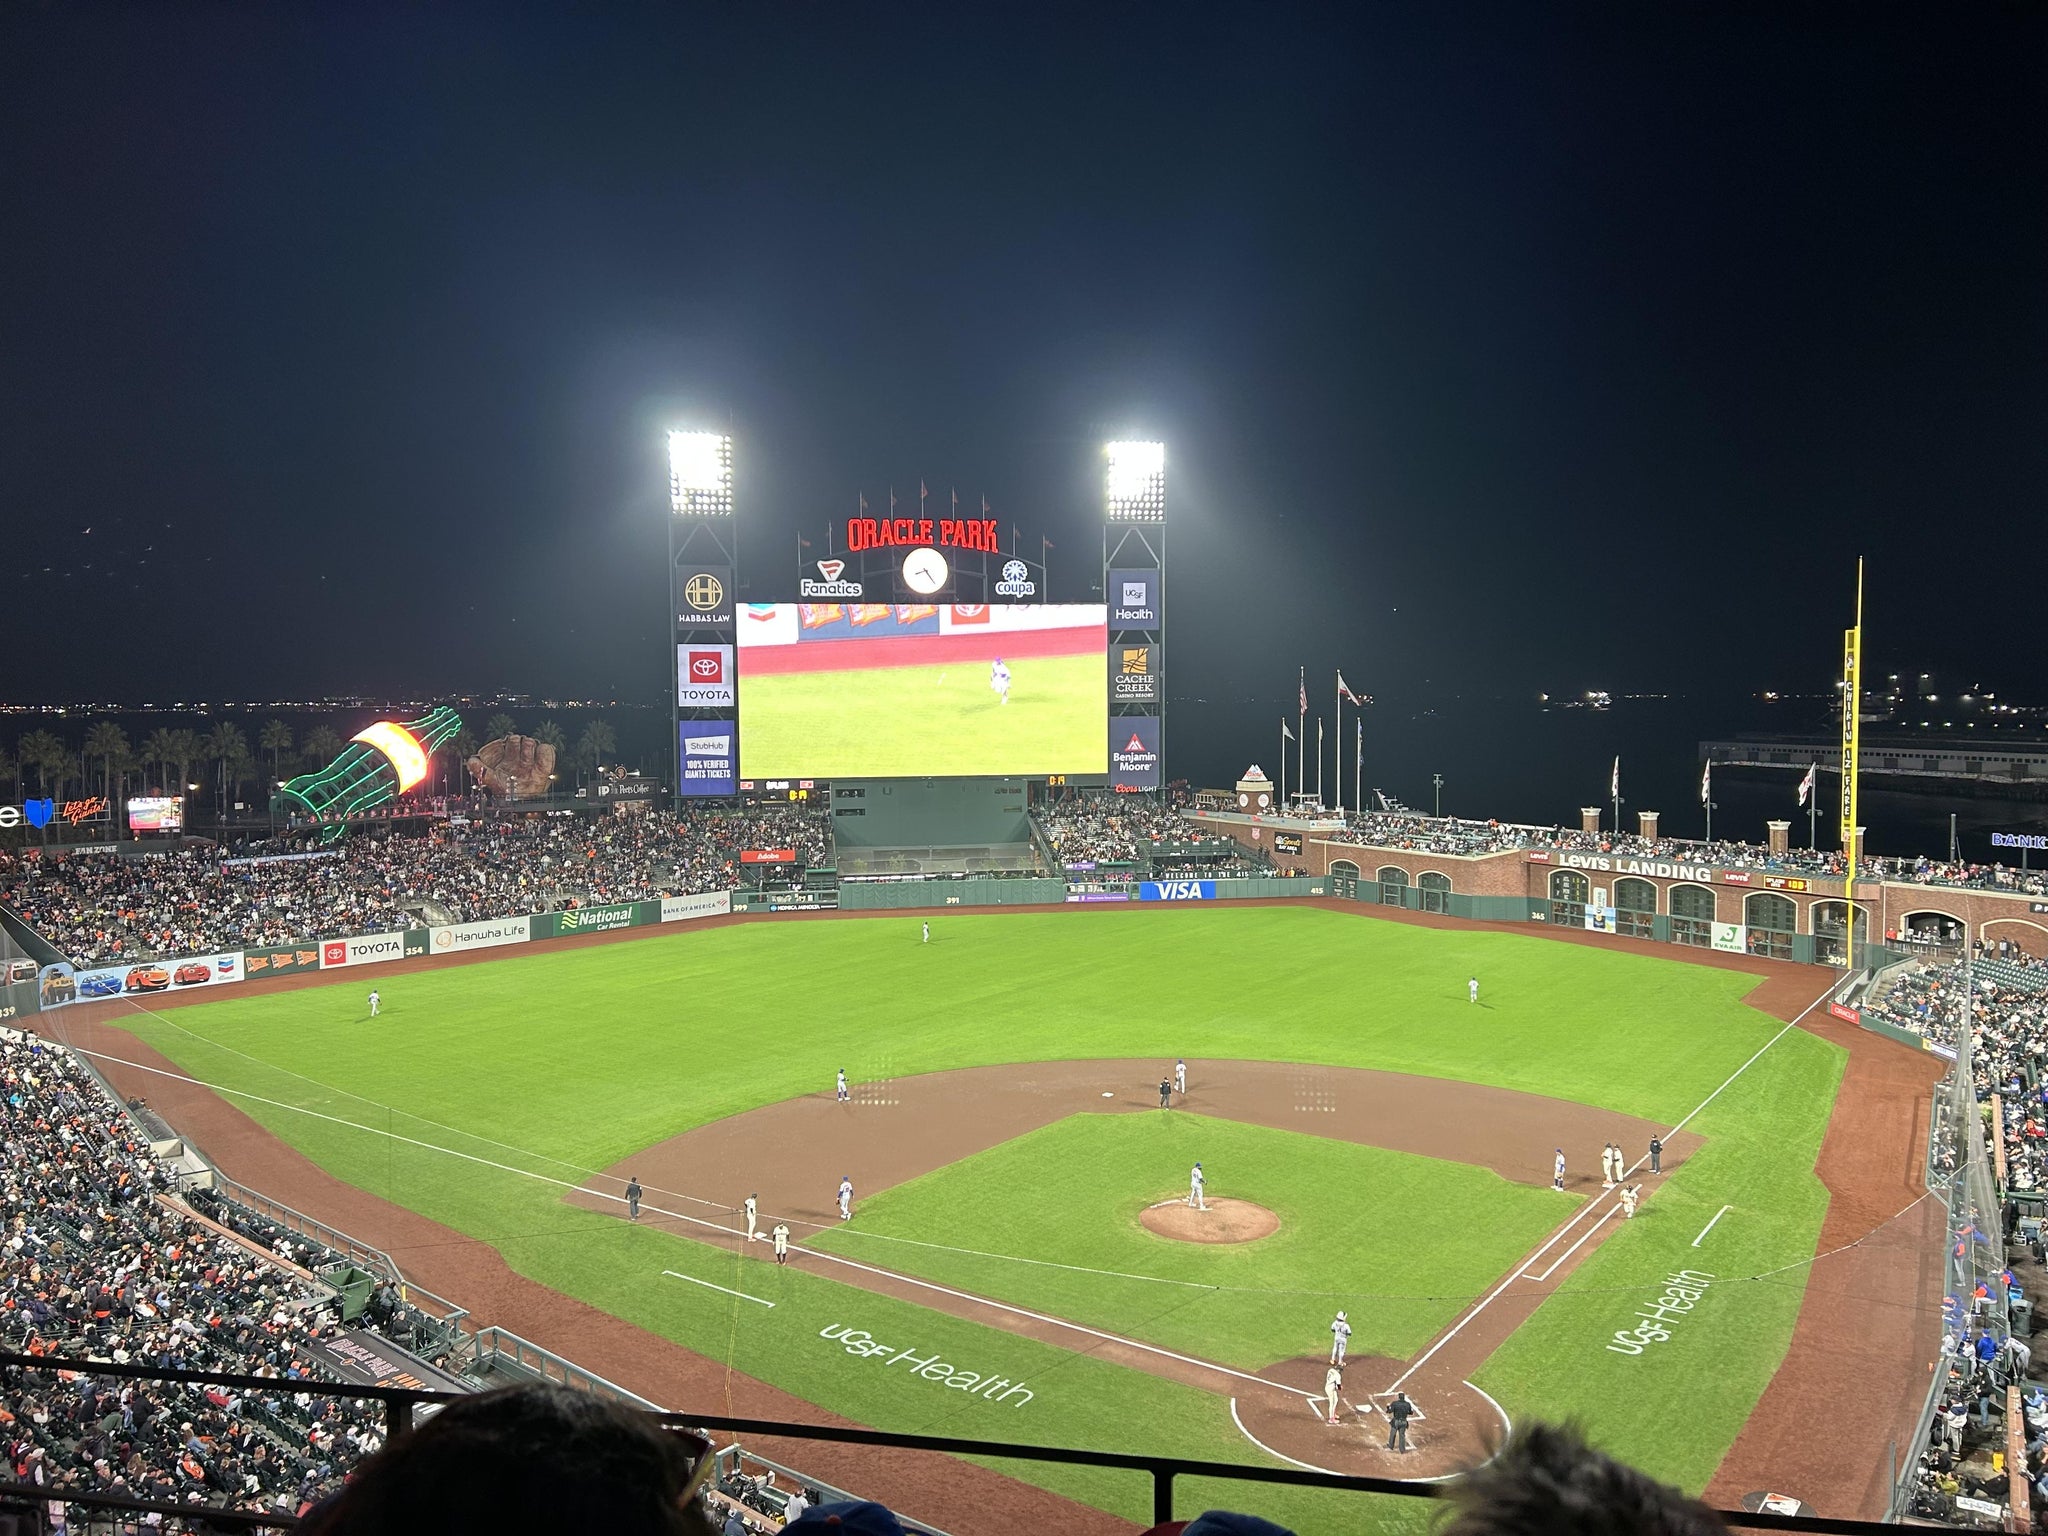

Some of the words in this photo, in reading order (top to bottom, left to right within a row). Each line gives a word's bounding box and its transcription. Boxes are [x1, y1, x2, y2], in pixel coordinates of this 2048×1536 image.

[847, 518, 934, 552] ORACLE
[939, 518, 999, 554] PARK
[803, 581, 861, 595] Fanatics
[997, 583, 1035, 596] coupa
[1125, 589, 1144, 599] UCSF
[678, 614, 712, 622] HABBAS
[712, 614, 731, 622] LAW
[1115, 608, 1154, 620] Health
[1115, 675, 1155, 684] CACHE
[1116, 684, 1153, 692] CREEK
[681, 690, 731, 700] TOYOTA
[690, 741, 724, 750] StubHub
[1113, 751, 1157, 764] Benjamin
[686, 760, 703, 770] 100%
[703, 759, 729, 770] VERIFIED
[1119, 761, 1150, 771] Moore
[684, 769, 706, 779] GIANTS
[706, 769, 731, 779] TICKETS
[633, 783, 650, 795] Coffee
[1115, 783, 1138, 794] Coors
[1992, 832, 2046, 849] BANK
[75, 846, 93, 855] FAN
[94, 845, 117, 854] ZONE
[757, 852, 780, 861] Adobe
[1165, 871, 1198, 879] WELCOME
[1236, 870, 1250, 878] 415
[1616, 858, 1712, 883] LANDING
[1765, 877, 1786, 885] SPLASH
[1154, 881, 1202, 900] VISA
[1310, 887, 1324, 895] 415
[946, 896, 960, 904] 391
[663, 907, 680, 915] BANK
[689, 902, 716, 911] AMERICA
[732, 903, 748, 911] 399
[579, 906, 632, 926] National
[1531, 911, 1546, 921] 365
[597, 923, 609, 931] Car
[609, 920, 630, 929] Rental
[455, 929, 502, 943] Hanwha
[504, 925, 525, 936] Life
[351, 941, 400, 957] TOYOTA
[405, 946, 424, 956] 354
[1714, 942, 1729, 950] EVA
[1828, 954, 1848, 966] 309
[1834, 1006, 1856, 1020] ORACLE
[1634, 1269, 1716, 1324] Health
[1605, 1319, 1672, 1355] UCSF
[325, 1338, 376, 1362] ORACLE
[363, 1356, 400, 1379] PARK
[819, 1323, 896, 1358] UCSF
[885, 1347, 1035, 1408] Health
